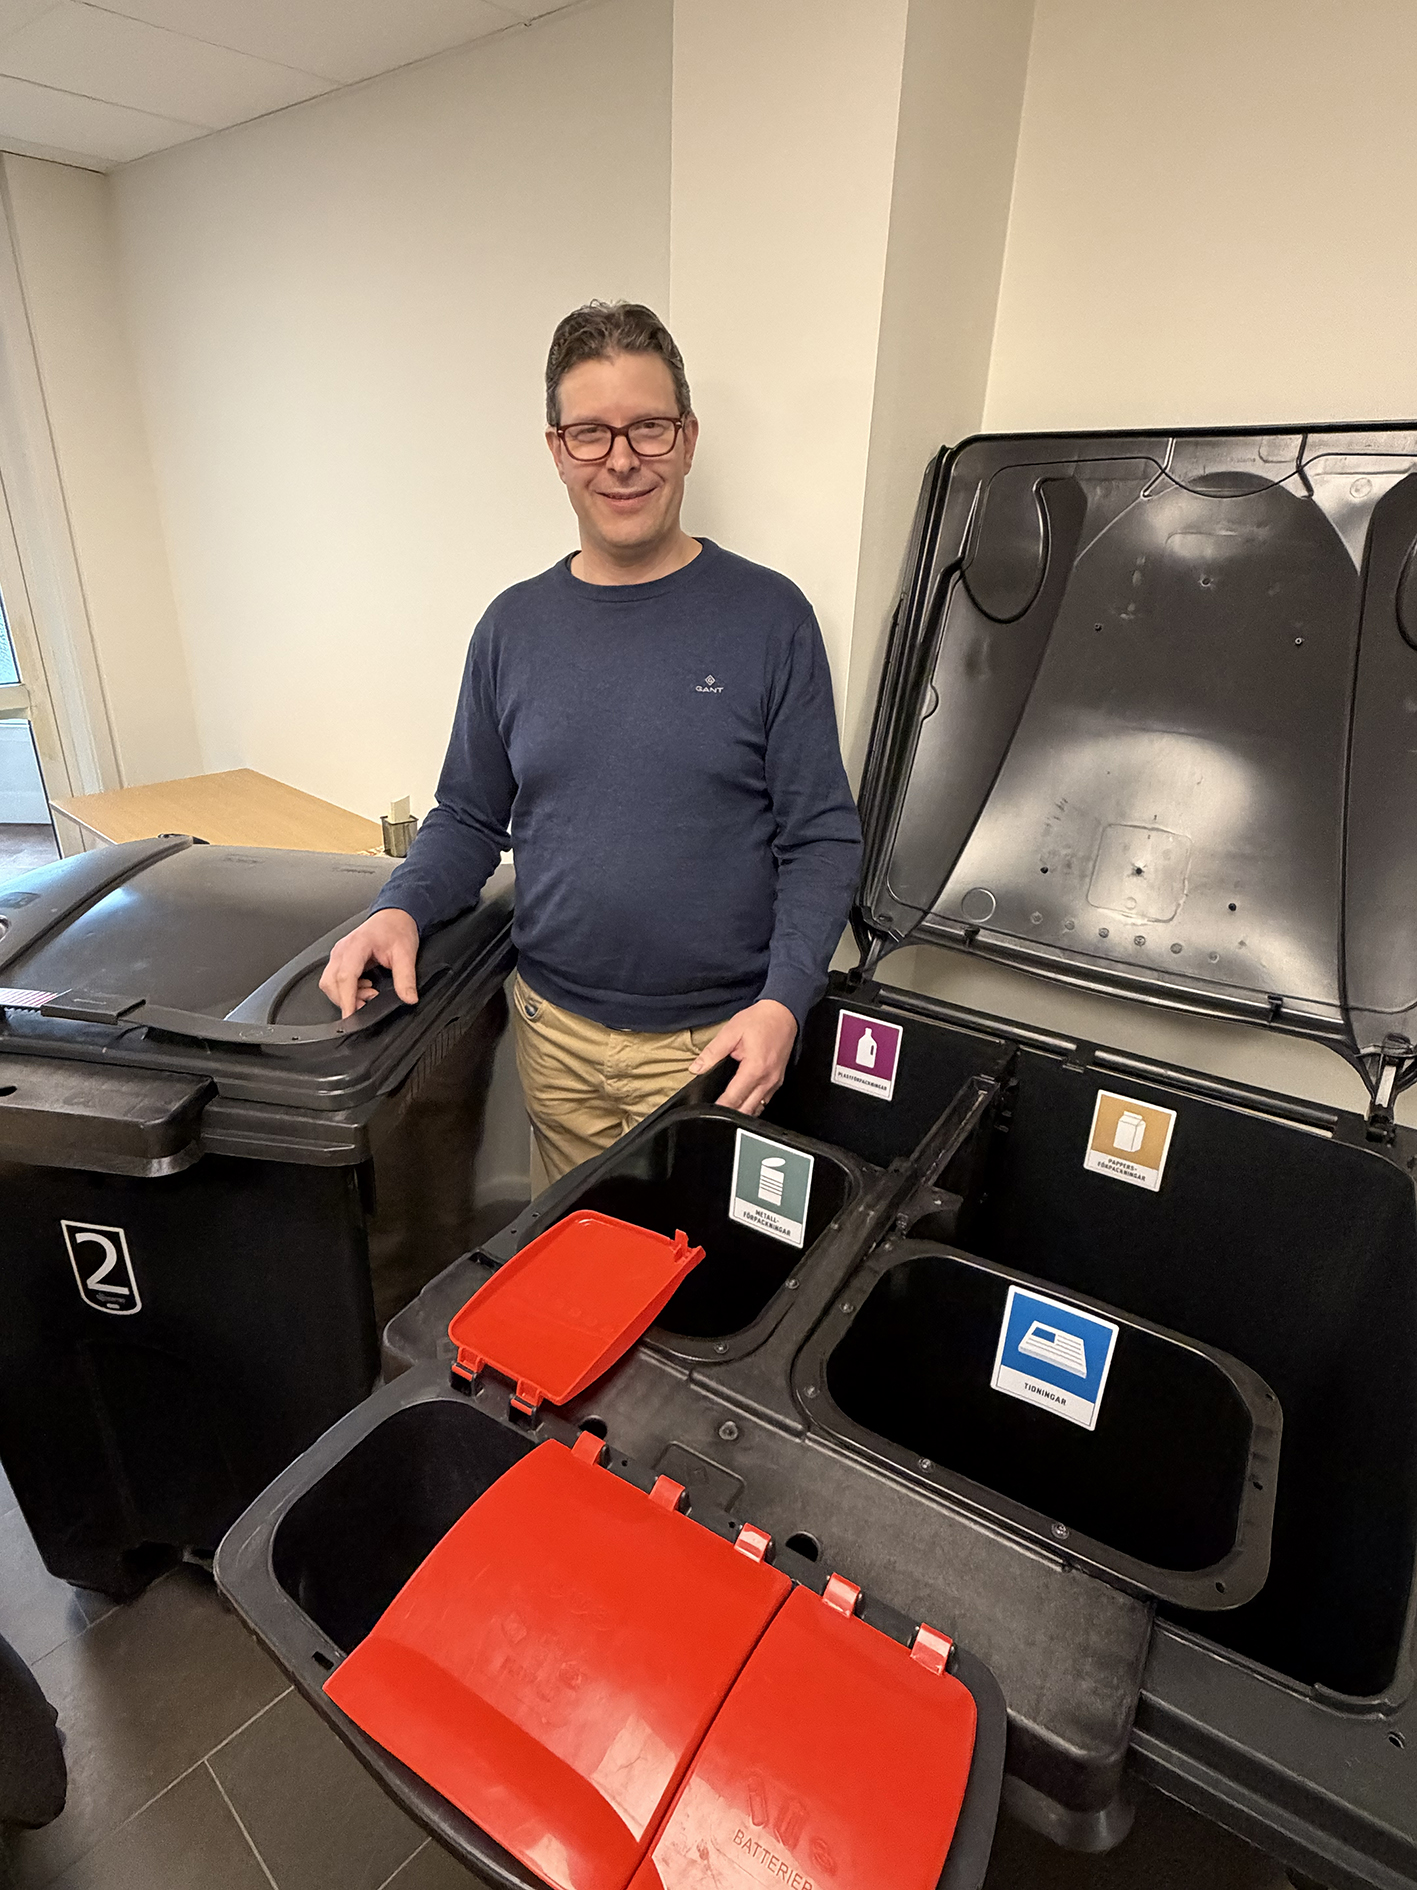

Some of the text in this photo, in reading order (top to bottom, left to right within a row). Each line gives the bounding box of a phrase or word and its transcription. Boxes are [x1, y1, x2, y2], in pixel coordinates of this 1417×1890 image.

[695, 685, 724, 693] GANT
[1097, 1161, 1146, 1182] FÖRPACKNINGAR
[1108, 1158, 1138, 1171] PAPPERS-
[743, 1211, 791, 1236] FÖRPACKNINGAR
[755, 1209, 779, 1224] METALL-
[75, 1232, 130, 1295] 2
[1024, 1382, 1067, 1406] TIDNINGAR
